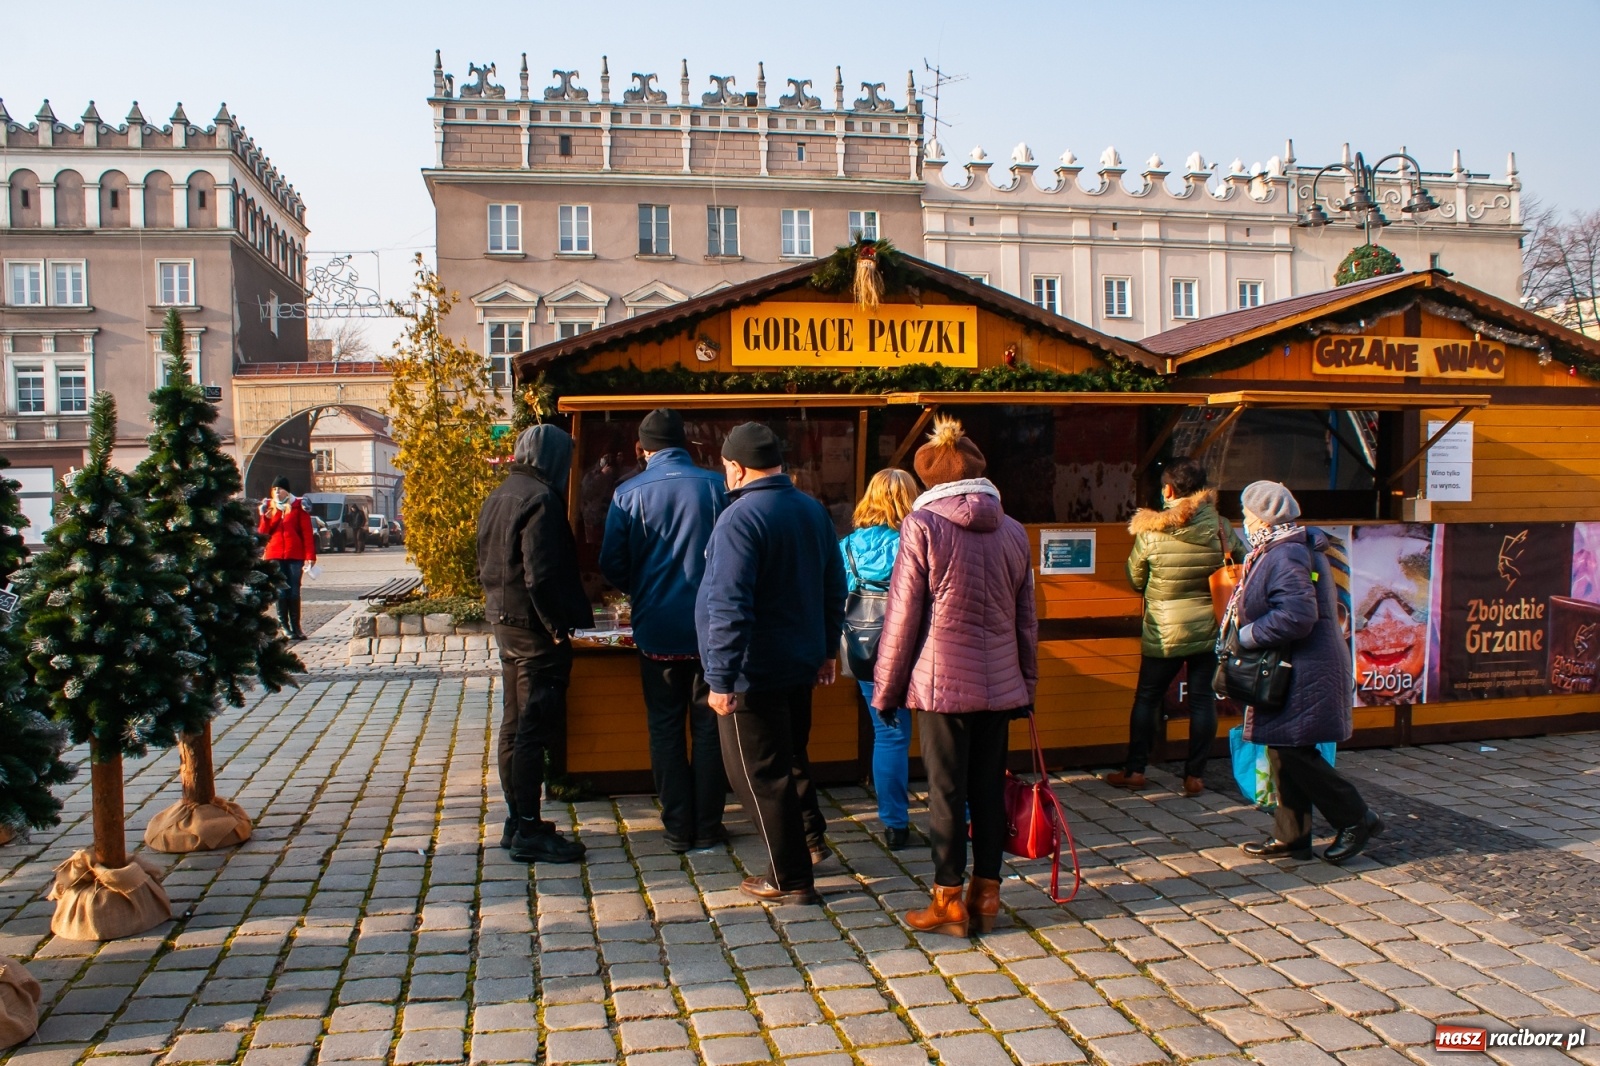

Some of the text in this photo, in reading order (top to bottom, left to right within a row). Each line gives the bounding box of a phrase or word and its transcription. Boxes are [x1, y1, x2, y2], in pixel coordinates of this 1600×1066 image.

[743, 316, 967, 358] GORĄCE PĄCZKI
[1315, 337, 1505, 374] GRZANE WINO
[1447, 469, 1460, 477] tylko
[1466, 597, 1545, 627] Zbójeckie
[1465, 624, 1544, 653] Grzane
[1361, 670, 1413, 694] Zbója
